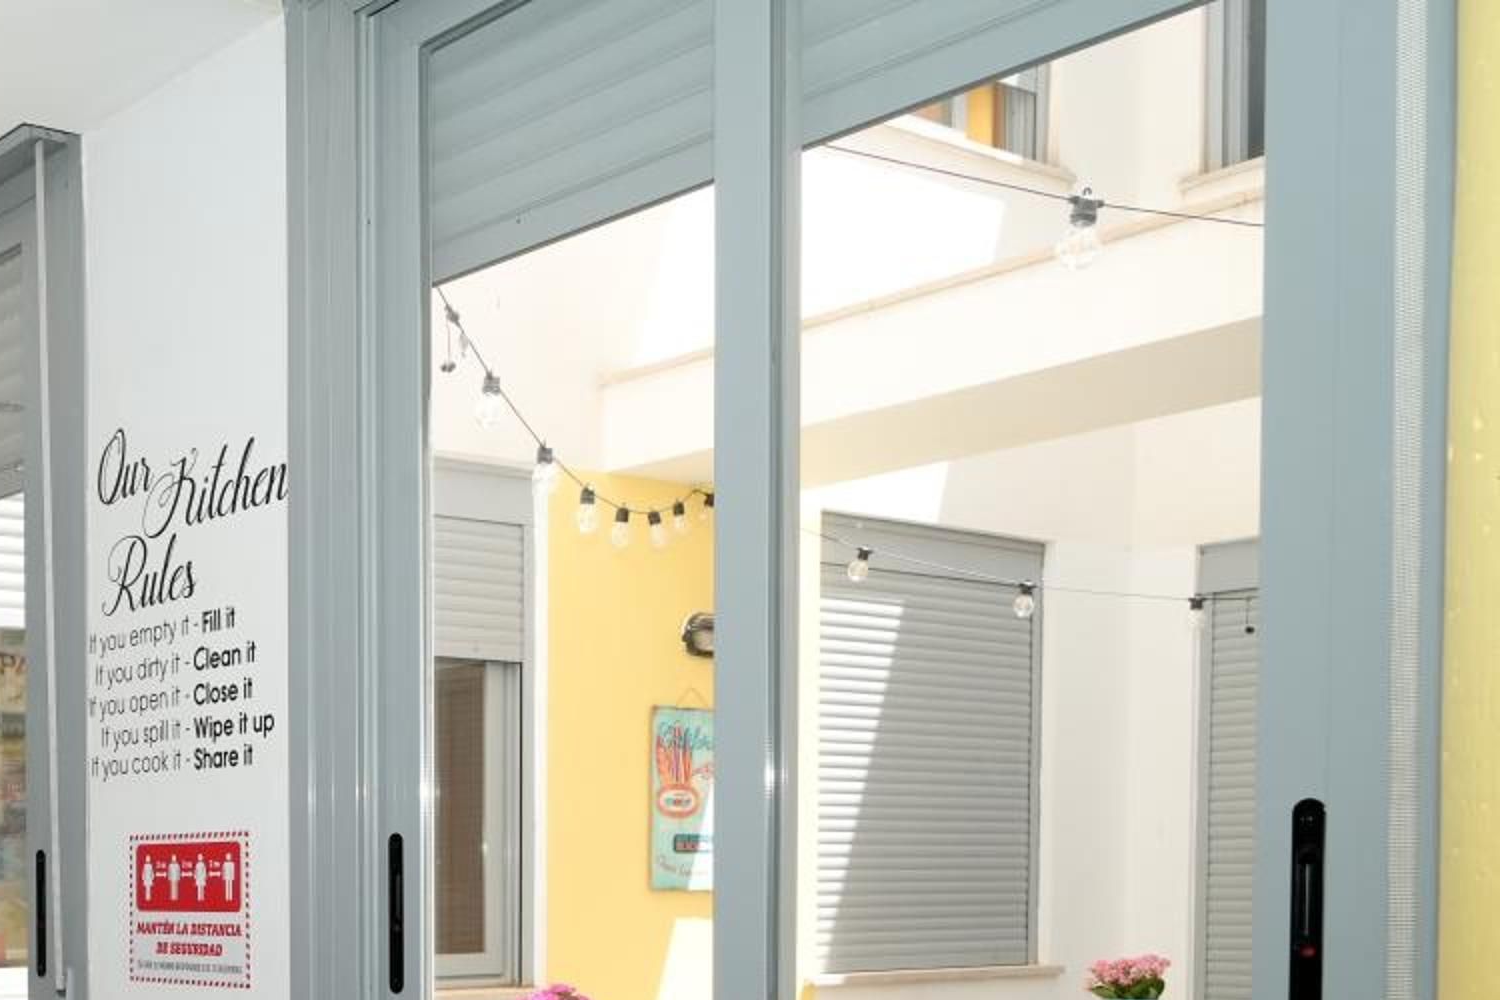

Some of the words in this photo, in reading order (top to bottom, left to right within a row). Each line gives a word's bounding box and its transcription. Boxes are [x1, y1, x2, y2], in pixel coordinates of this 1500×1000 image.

[97, 428, 150, 505] Our
[142, 436, 288, 539] Kitchen
[101, 533, 195, 616] Rules
[89, 634, 97, 654] If
[99, 634, 125, 658] you
[129, 620, 177, 648] empty
[181, 615, 189, 636] it
[202, 609, 221, 633] Fill
[226, 607, 236, 629] it
[95, 665, 103, 686] If
[107, 665, 133, 691] you
[137, 657, 168, 682] dirty
[171, 652, 180, 674] it
[193, 646, 241, 671] Clean
[246, 641, 256, 663] it
[89, 695, 97, 718] If
[99, 699, 125, 723] you
[129, 690, 169, 717] open
[171, 686, 181, 707] it
[193, 682, 239, 706] Close
[243, 677, 253, 699] it
[101, 727, 109, 748] If
[113, 728, 139, 752] you
[143, 719, 169, 747] spill
[171, 718, 181, 740] it
[193, 715, 234, 743] Wipe
[239, 712, 248, 734] it
[253, 713, 275, 738] up
[91, 756, 99, 777] If
[102, 758, 129, 782] you
[132, 752, 169, 775] cook
[173, 751, 181, 771] it
[193, 747, 239, 770] Share
[243, 744, 253, 766] it
[175, 923, 188, 935] LA
[190, 923, 242, 937] DISTANCIA
